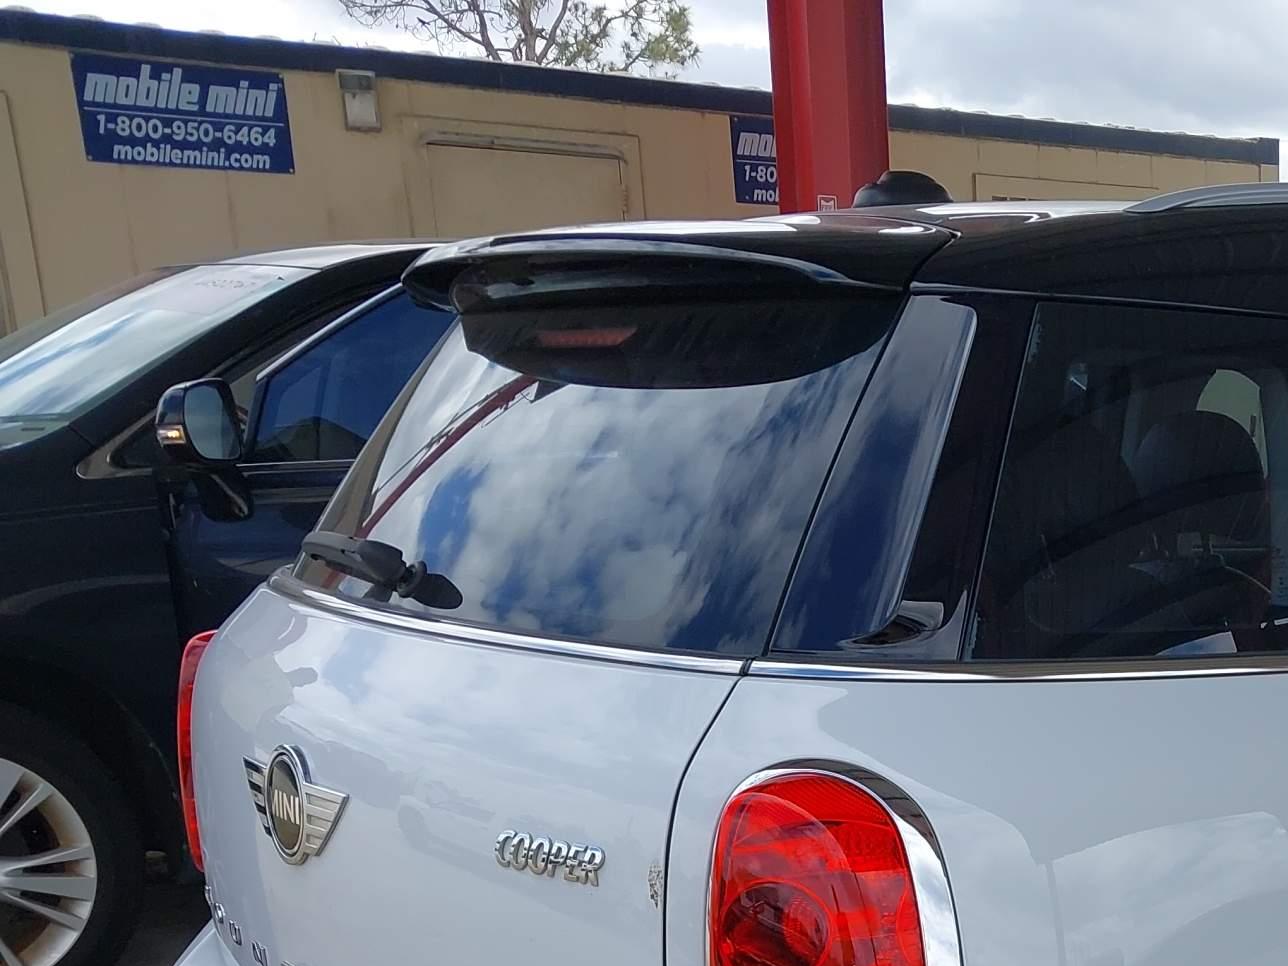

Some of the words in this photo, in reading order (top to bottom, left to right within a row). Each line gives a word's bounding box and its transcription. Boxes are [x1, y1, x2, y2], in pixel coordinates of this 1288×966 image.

[83, 63, 200, 112] mobile
[205, 80, 279, 118] mini
[97, 114, 277, 148] 1-800-950-6464
[113, 143, 271, 170] mobilemini.com
[494, 829, 606, 888] COOPER
